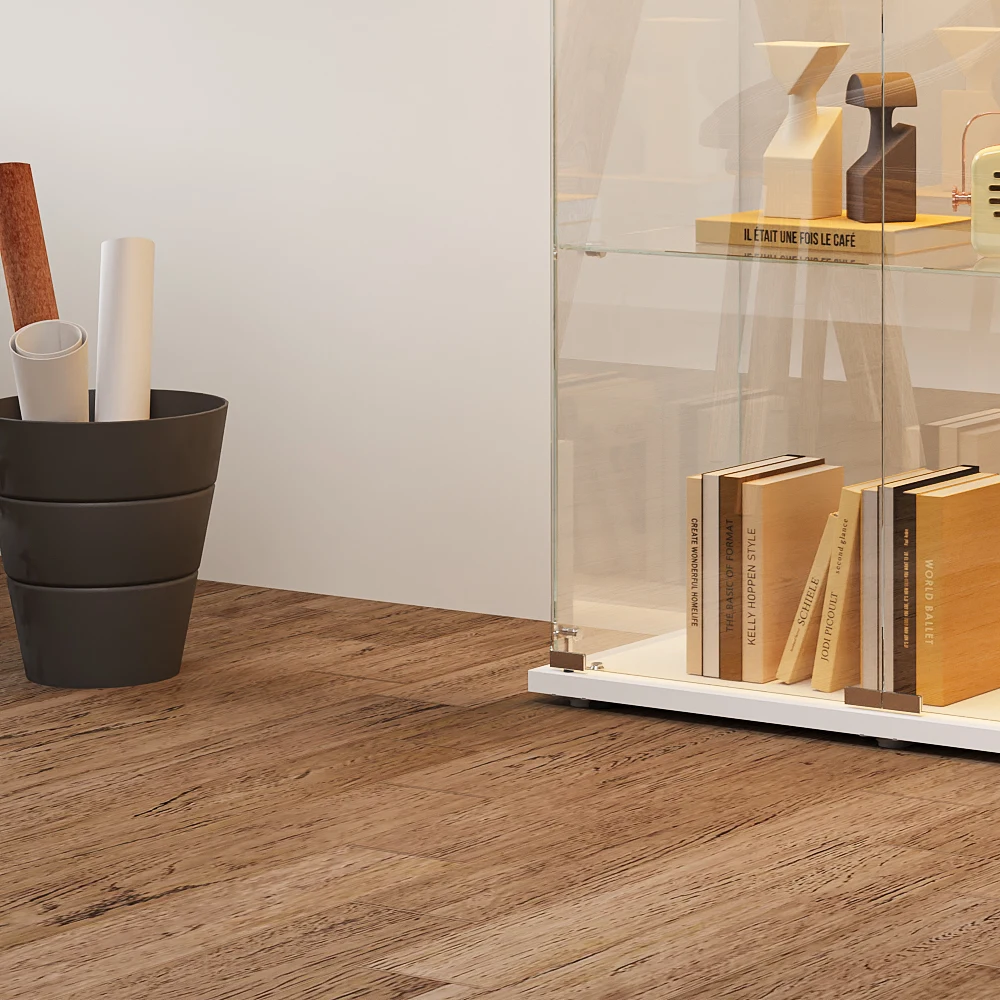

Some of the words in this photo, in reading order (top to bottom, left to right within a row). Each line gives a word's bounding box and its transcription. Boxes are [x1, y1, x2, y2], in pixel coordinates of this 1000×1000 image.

[744, 228, 752, 241] IL
[754, 226, 778, 243] ÉTAIT
[780, 230, 797, 244] UNE
[800, 231, 819, 245] FOIS
[821, 233, 831, 246] LE
[833, 232, 856, 247] CAFÉ
[726, 519, 734, 561] FORMAT
[747, 528, 756, 561] STYLE
[839, 518, 848, 545] glance
[726, 564, 734, 578] OF
[835, 546, 844, 574] second
[726, 582, 734, 609] BASIC
[747, 564, 756, 609] HOPPEN
[924, 560, 933, 600] WORLD
[797, 577, 819, 626] SCHIELE
[824, 592, 838, 636] PICOULT
[726, 613, 734, 632] THE
[747, 612, 756, 645] KELLY
[924, 605, 933, 645] BALLET
[820, 636, 831, 662] JODI
